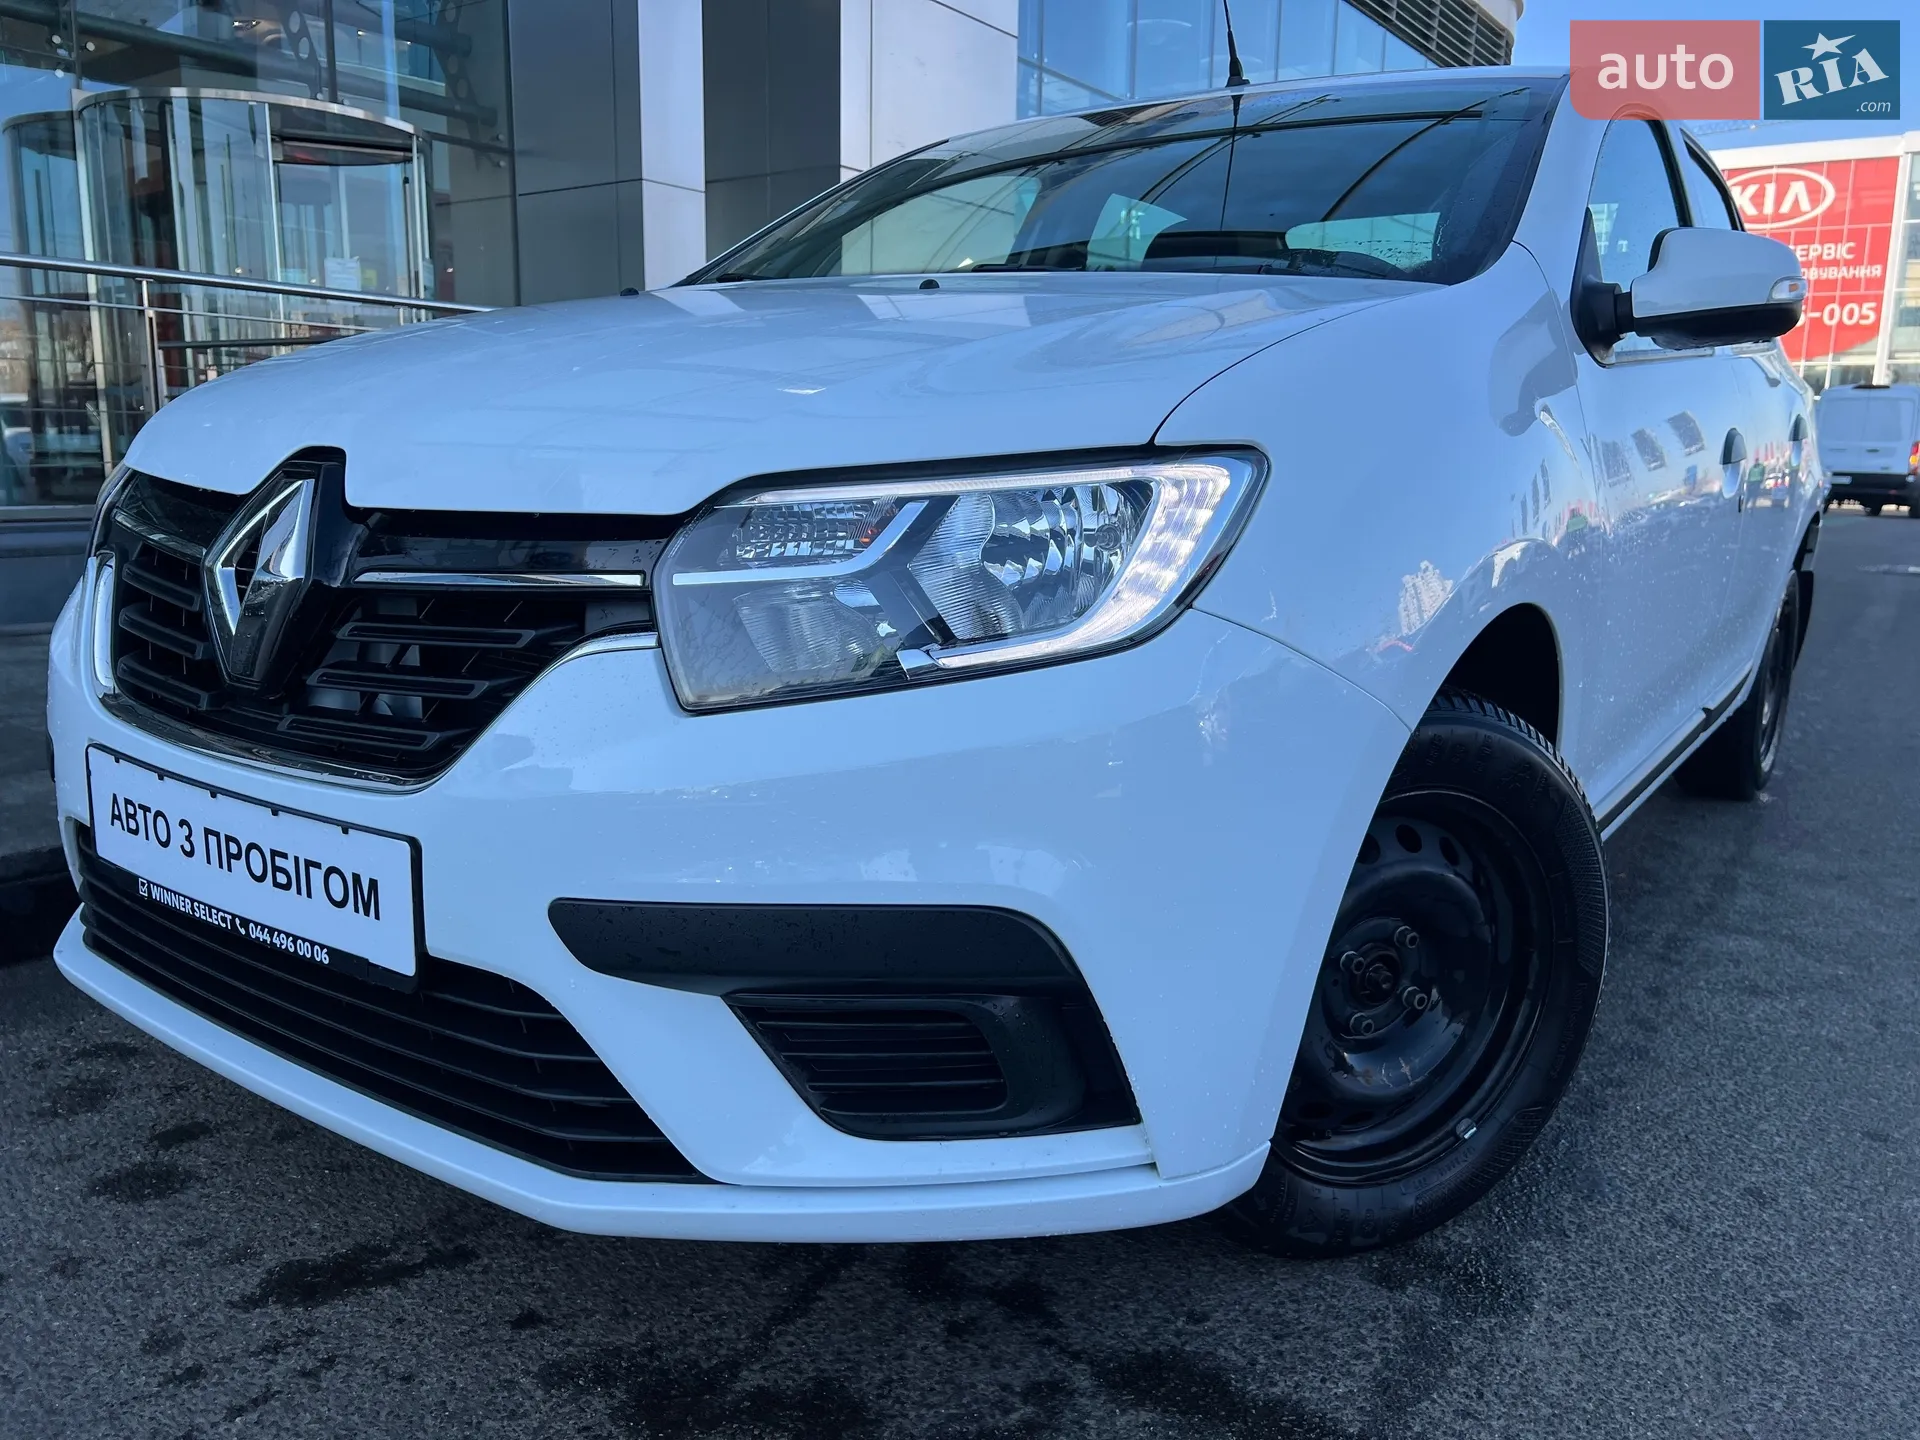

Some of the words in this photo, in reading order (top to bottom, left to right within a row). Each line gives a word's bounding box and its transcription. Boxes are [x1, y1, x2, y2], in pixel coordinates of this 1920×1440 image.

[1731, 180, 1812, 216] KIA
[1789, 242, 1856, 261] ЕРВІС
[1801, 264, 1882, 280] ОВУВАННЯ
[110, 793, 171, 849] АВТО
[178, 818, 195, 859] З
[203, 827, 381, 921] ПРОБІГОМ
[150, 884, 193, 915] WINNER
[194, 902, 233, 930] SELECT
[249, 922, 271, 944] 044
[272, 931, 295, 953] 496
[296, 939, 312, 959] 00
[313, 945, 330, 965] 06
